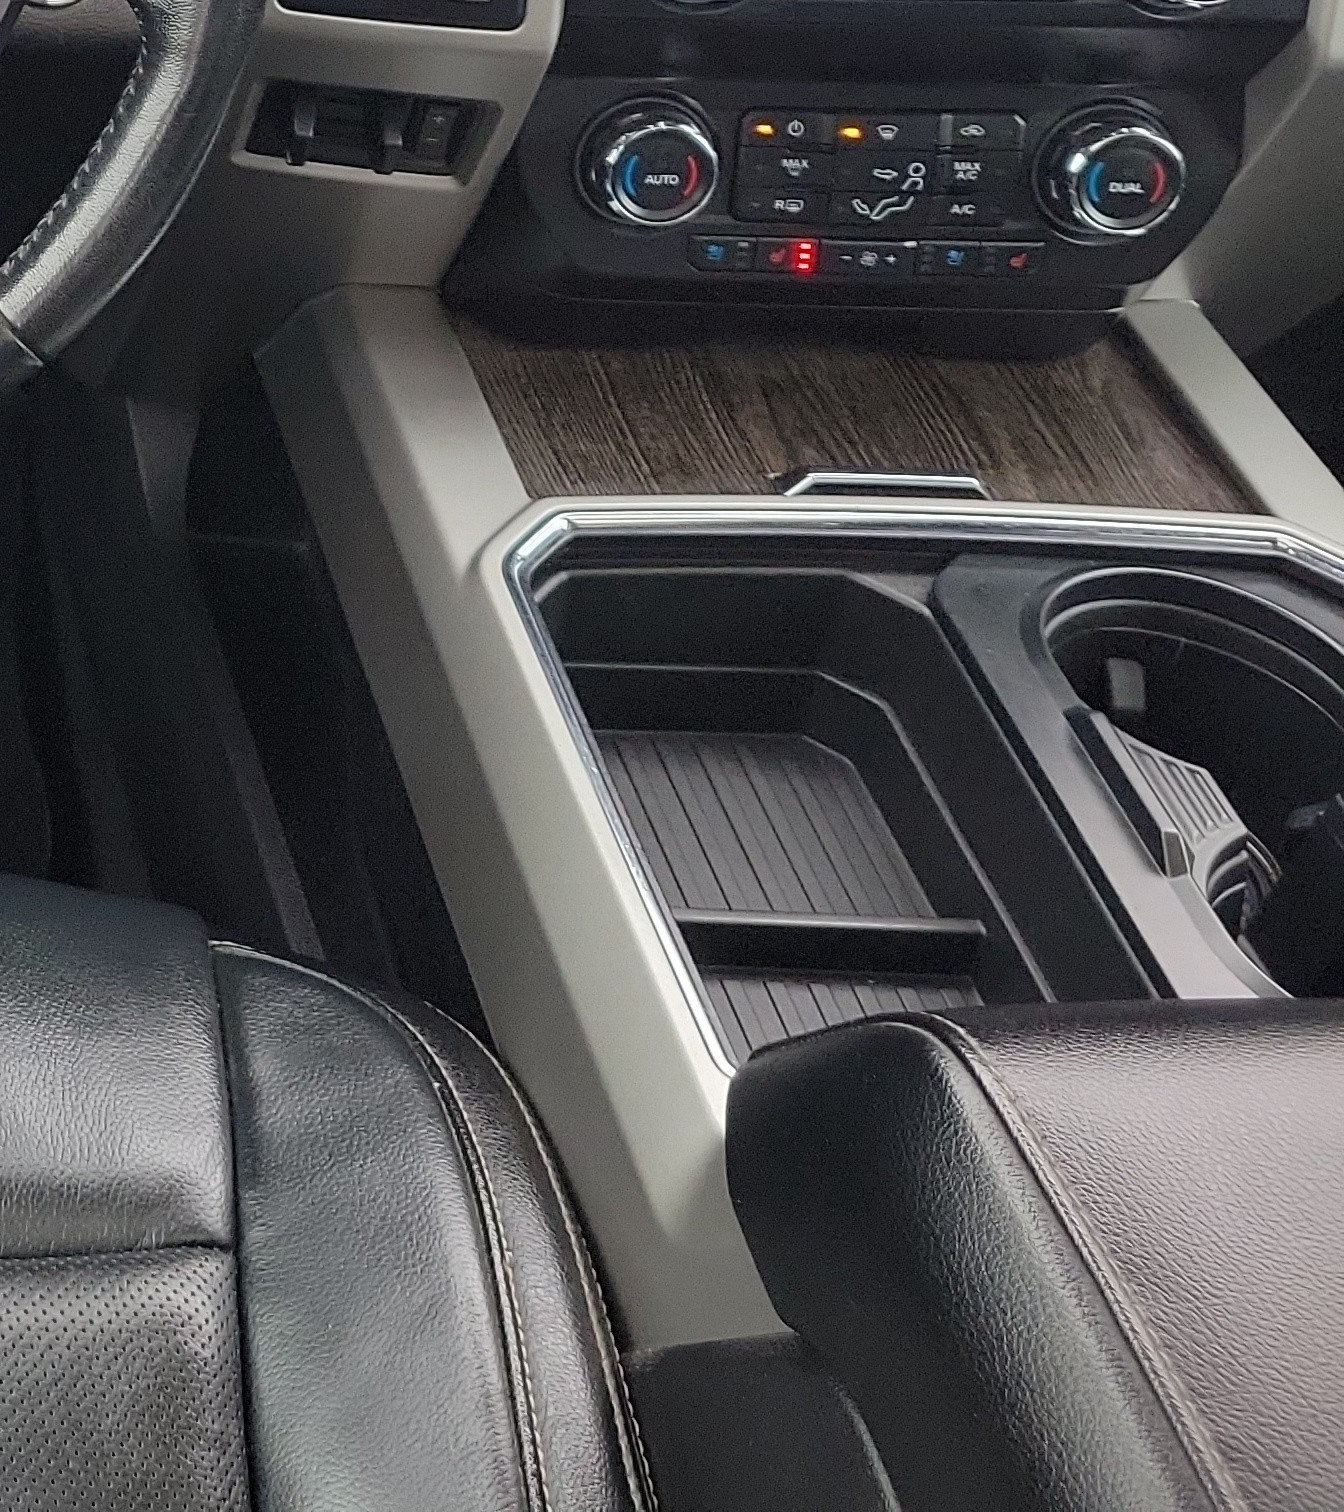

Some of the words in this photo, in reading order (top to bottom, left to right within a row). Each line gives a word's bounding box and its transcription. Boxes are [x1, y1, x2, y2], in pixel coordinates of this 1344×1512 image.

[953, 161, 982, 172] MAX
[644, 173, 680, 186] AUTO
[955, 170, 979, 181] A/C
[949, 204, 976, 215] A/C
